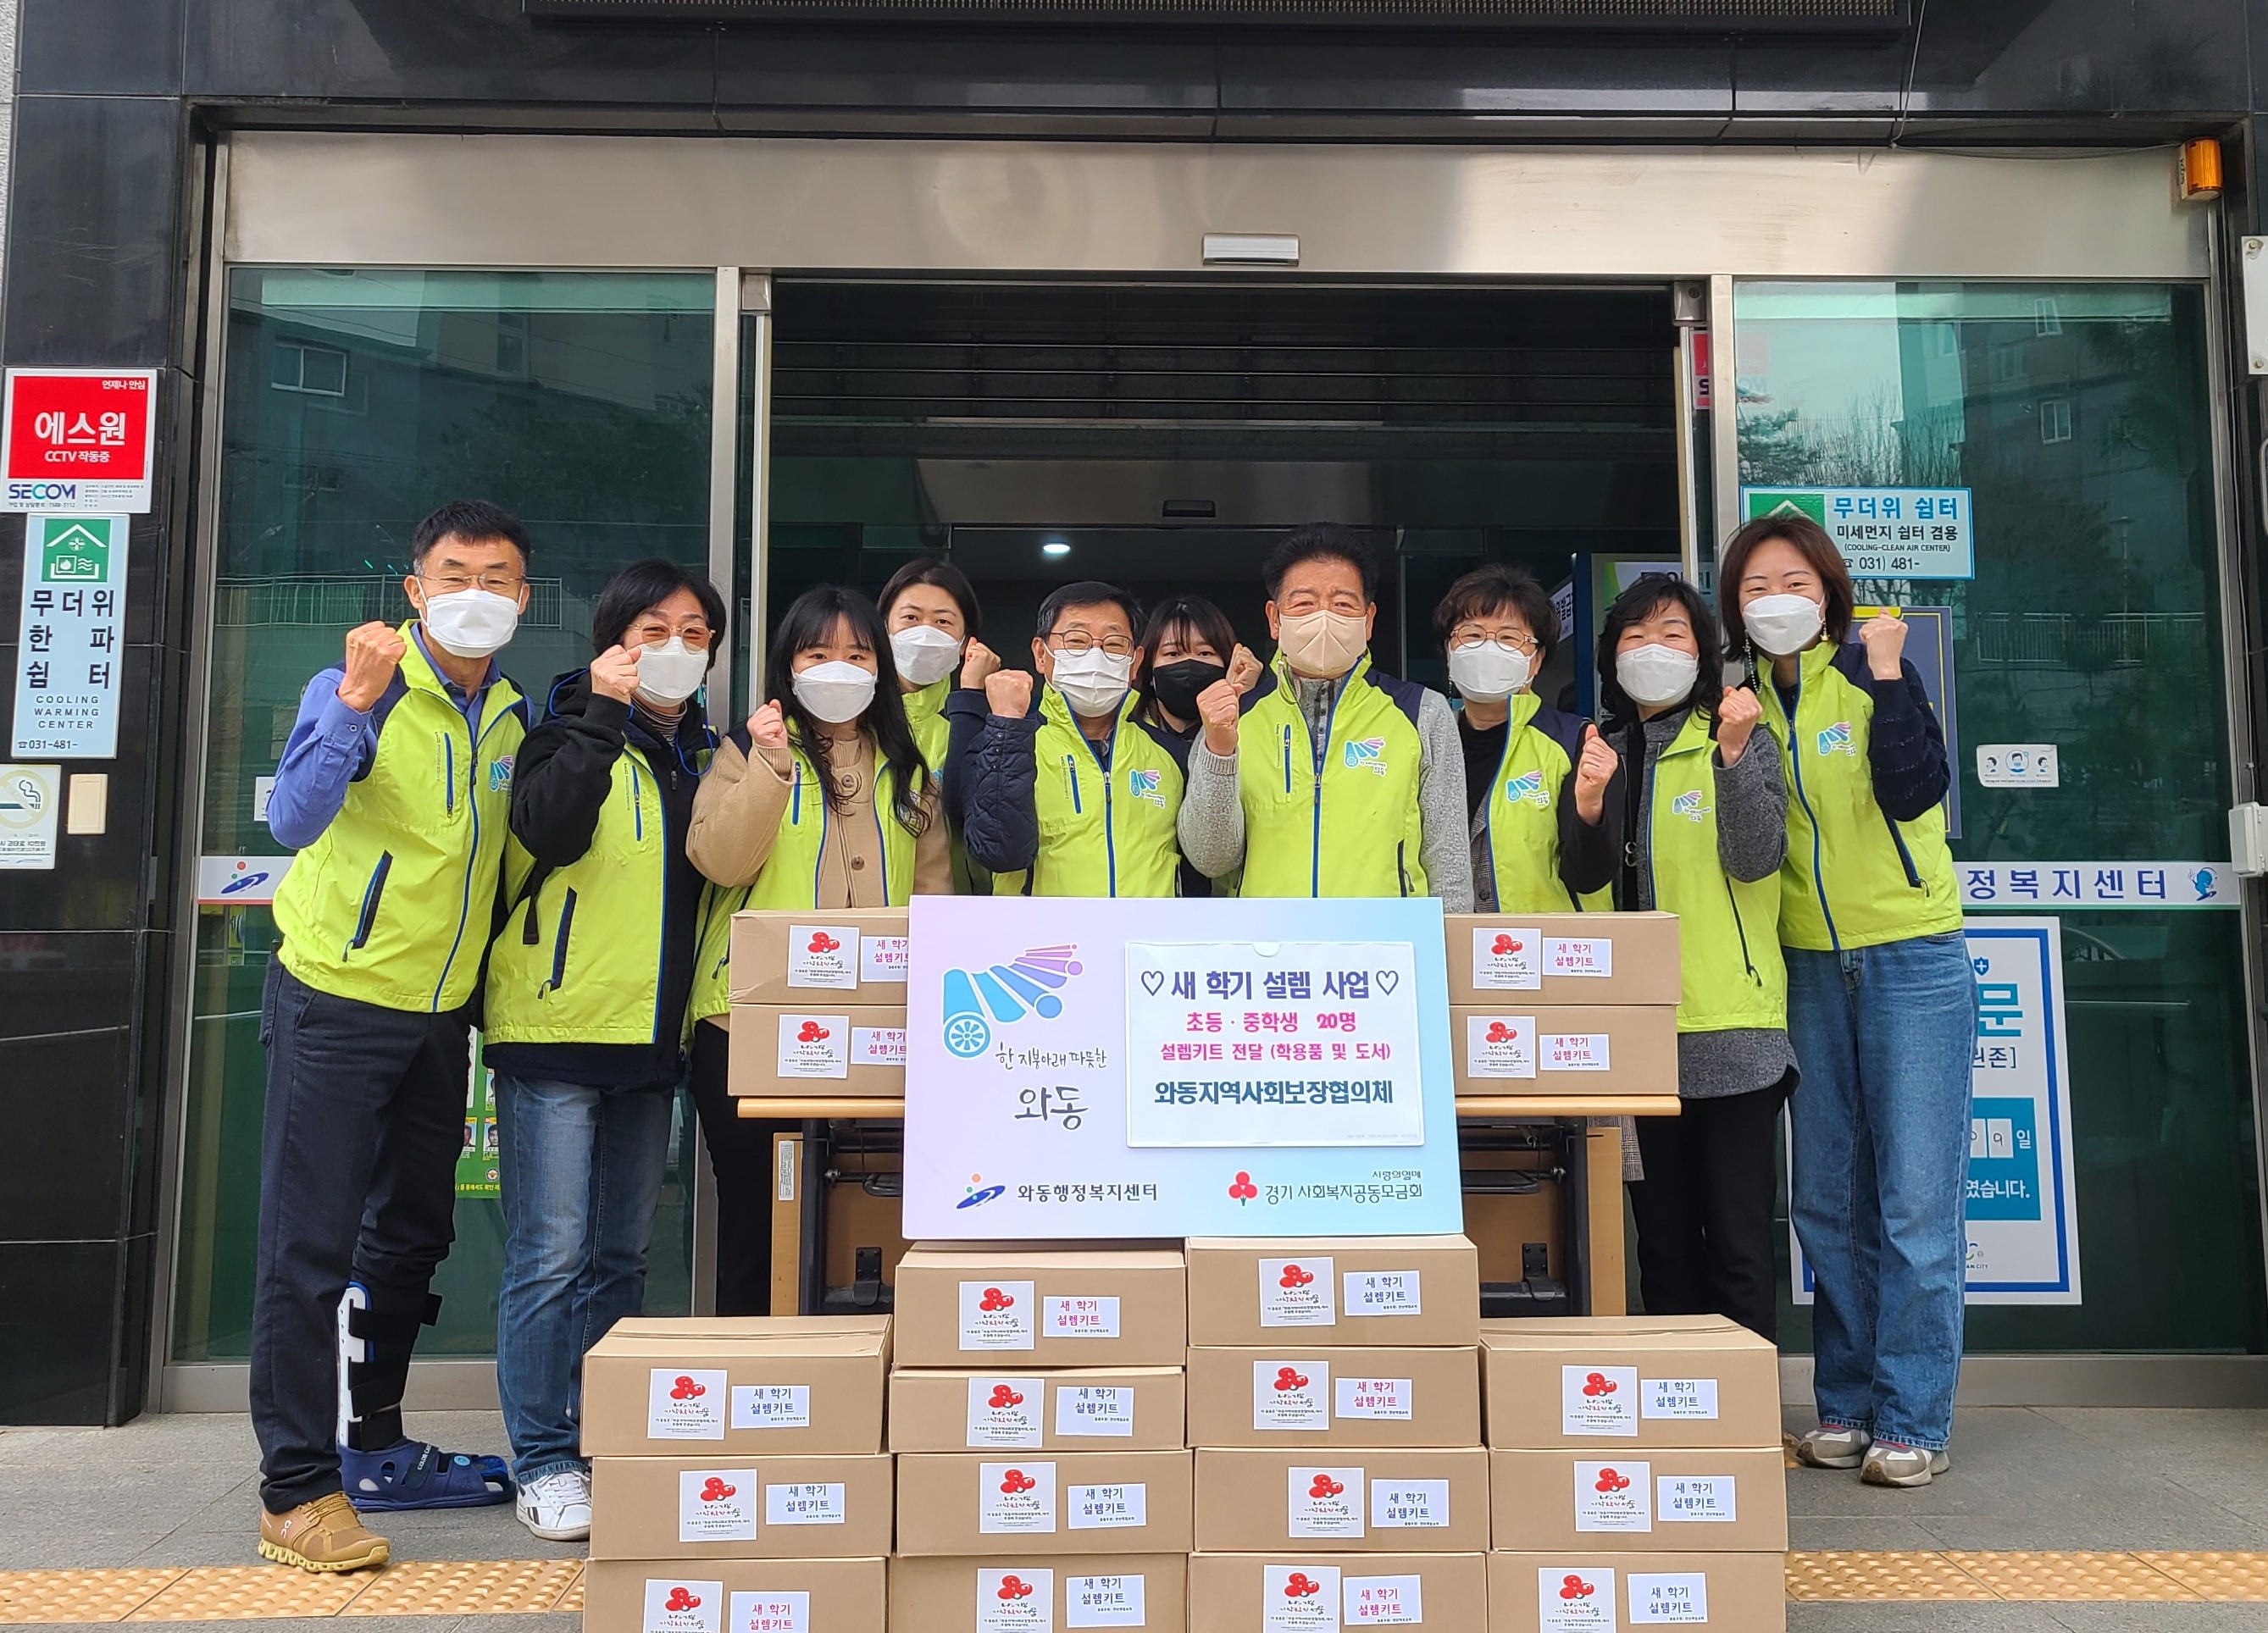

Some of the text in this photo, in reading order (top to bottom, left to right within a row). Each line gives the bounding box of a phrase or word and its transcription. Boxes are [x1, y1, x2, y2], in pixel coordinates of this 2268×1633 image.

[128, 379, 146, 390] 안심
[35, 411, 126, 446] 에스원
[44, 450, 110, 463] CCTV 작동중
[8, 484, 76, 501] SECOM
[1833, 496, 1958, 520] 무더위 쉼터
[1837, 524, 1958, 541] 미세먼지 쉼터 겸용
[1920, 544, 1951, 553] CENTER)
[1859, 555, 1920, 572] 031) 481-
[30, 590, 114, 617] 무더위
[36, 695, 98, 704] COOLING
[34, 707, 99, 717] WARMING
[37, 720, 93, 729] CENTER
[29, 739, 79, 750] 031-481-
[876, 939, 886, 950] 새
[1557, 943, 1591, 955] 새 학기
[1171, 971, 1369, 1000] 새 학기 설렘 사업
[1186, 1011, 1356, 1033] 초등 중학생 20명
[871, 1031, 881, 1042] 새
[1555, 1037, 1589, 1048] 새 학기
[1161, 1043, 1391, 1061] 설렘키트 전달 (학용품 및 도서)
[1154, 1080, 1393, 1105] 와동지역사회보장협의체
[1014, 1086, 1089, 1131] 와동
[1018, 1183, 1156, 1203] 와동행정복지센터
[1265, 1183, 1422, 1205] 경기 사회복지공동모금회
[1365, 1276, 1403, 1289] 새 학기
[1060, 1300, 1097, 1312] 새 학기
[753, 1387, 791, 1400] 새 학기
[1078, 1387, 1116, 1400] 새 학기
[1356, 1381, 1394, 1393] 새 학기
[1658, 1381, 1695, 1393] 새 학기
[788, 1485, 827, 1497] 새 학기
[1085, 1487, 1123, 1500] 새 학기
[1675, 1482, 1712, 1495] 새 학기
[1389, 1492, 1427, 1505] 새 학기
[1084, 1577, 1122, 1590] 새 학기
[1361, 1588, 1398, 1601] 새 학기
[1650, 1586, 1689, 1599] 새 학기
[752, 1603, 790, 1616] 새 학기
